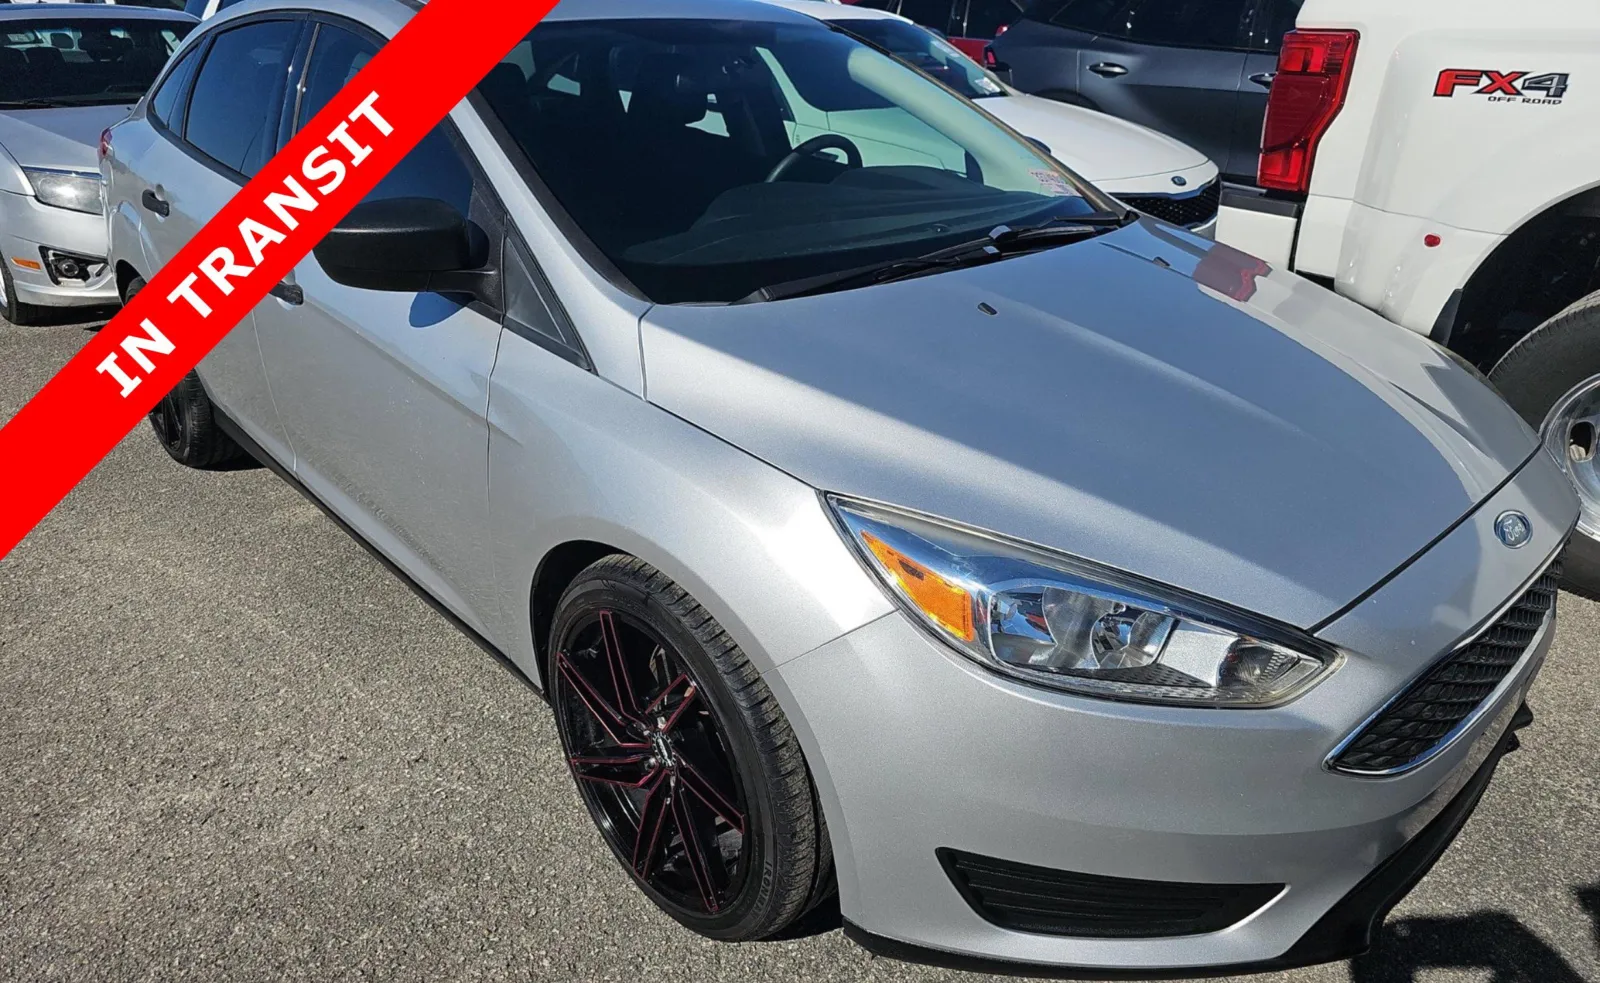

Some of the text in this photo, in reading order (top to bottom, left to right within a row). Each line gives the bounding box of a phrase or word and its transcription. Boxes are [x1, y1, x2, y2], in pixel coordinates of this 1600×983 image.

[1433, 68, 1569, 97] FX4
[1487, 95, 1562, 105] OFF ROAD
